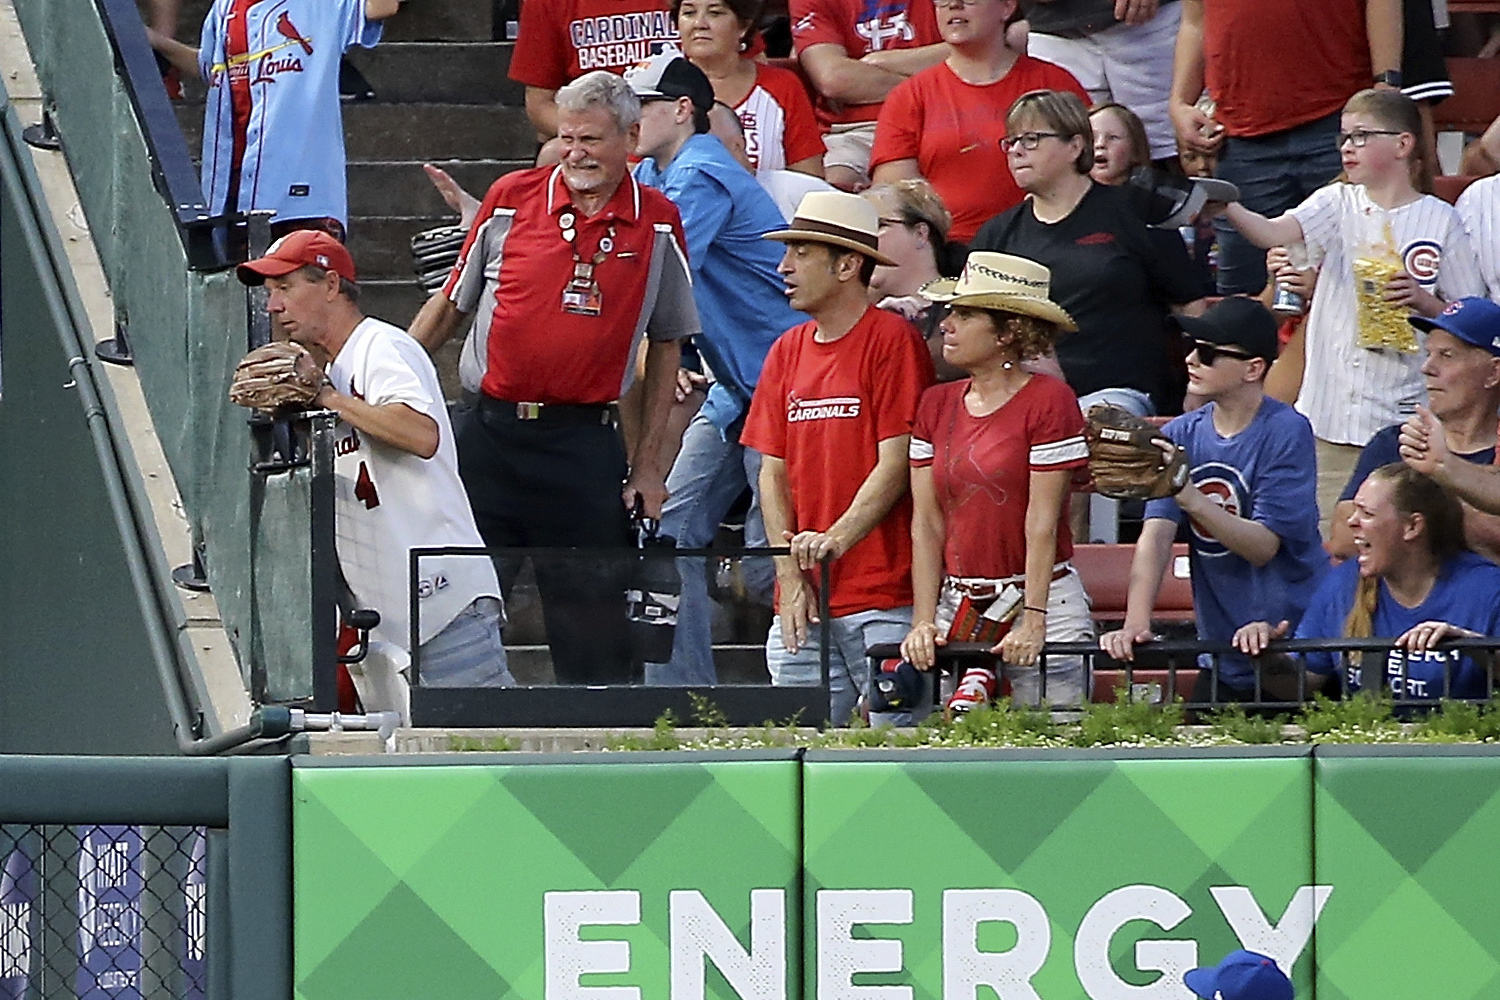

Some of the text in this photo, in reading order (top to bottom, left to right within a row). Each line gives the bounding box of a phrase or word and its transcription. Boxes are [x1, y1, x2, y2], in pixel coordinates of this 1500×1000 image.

[251, 52, 304, 87] Louis
[578, 41, 649, 70] BASEBALL
[787, 405, 861, 423] CARDINALS
[97, 842, 129, 888] HYATT
